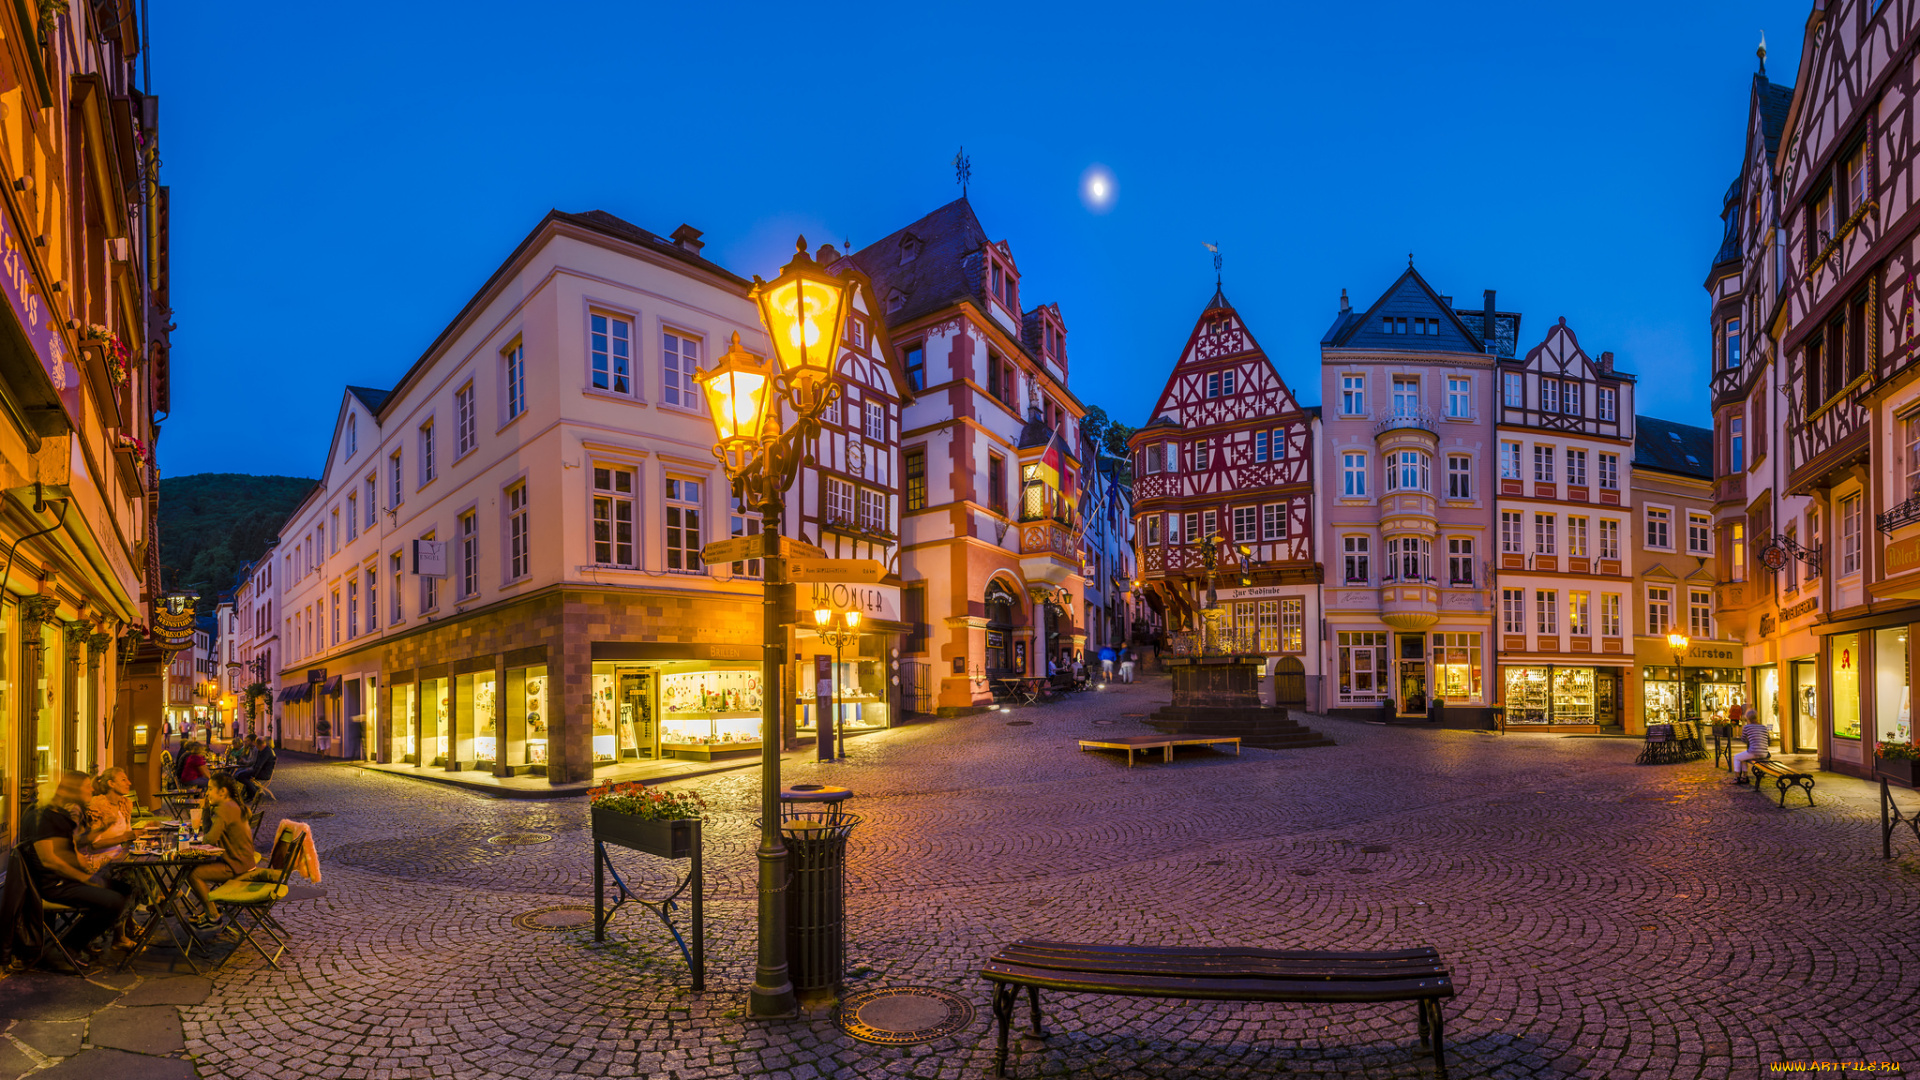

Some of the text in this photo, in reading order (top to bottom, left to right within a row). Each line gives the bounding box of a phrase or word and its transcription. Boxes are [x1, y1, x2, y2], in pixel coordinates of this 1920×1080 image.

[1233, 587, 1280, 598] Zur Badstube
[157, 615, 194, 628] WEINSTUBE
[1688, 646, 1733, 659] Kirsten
